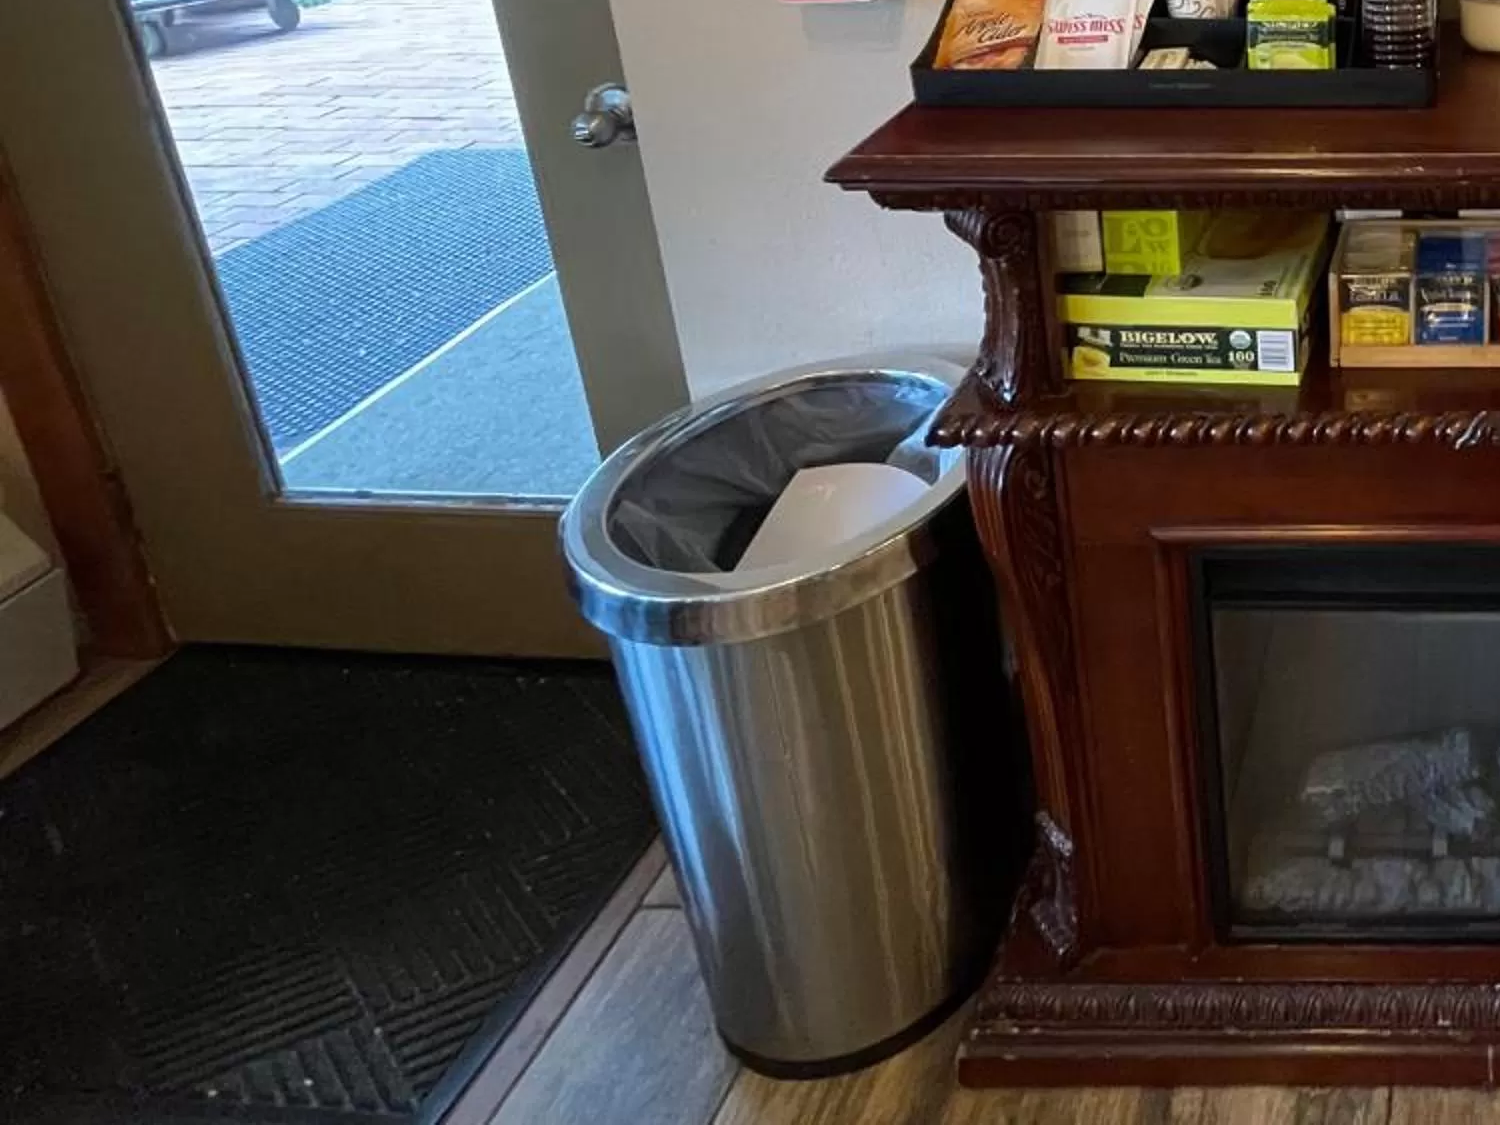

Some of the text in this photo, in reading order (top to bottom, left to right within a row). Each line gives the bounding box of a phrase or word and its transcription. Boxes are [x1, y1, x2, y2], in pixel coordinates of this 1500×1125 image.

[1119, 329, 1217, 345] BIGELOW
[1170, 350, 1202, 365] Green
[1228, 350, 1255, 363] 160
